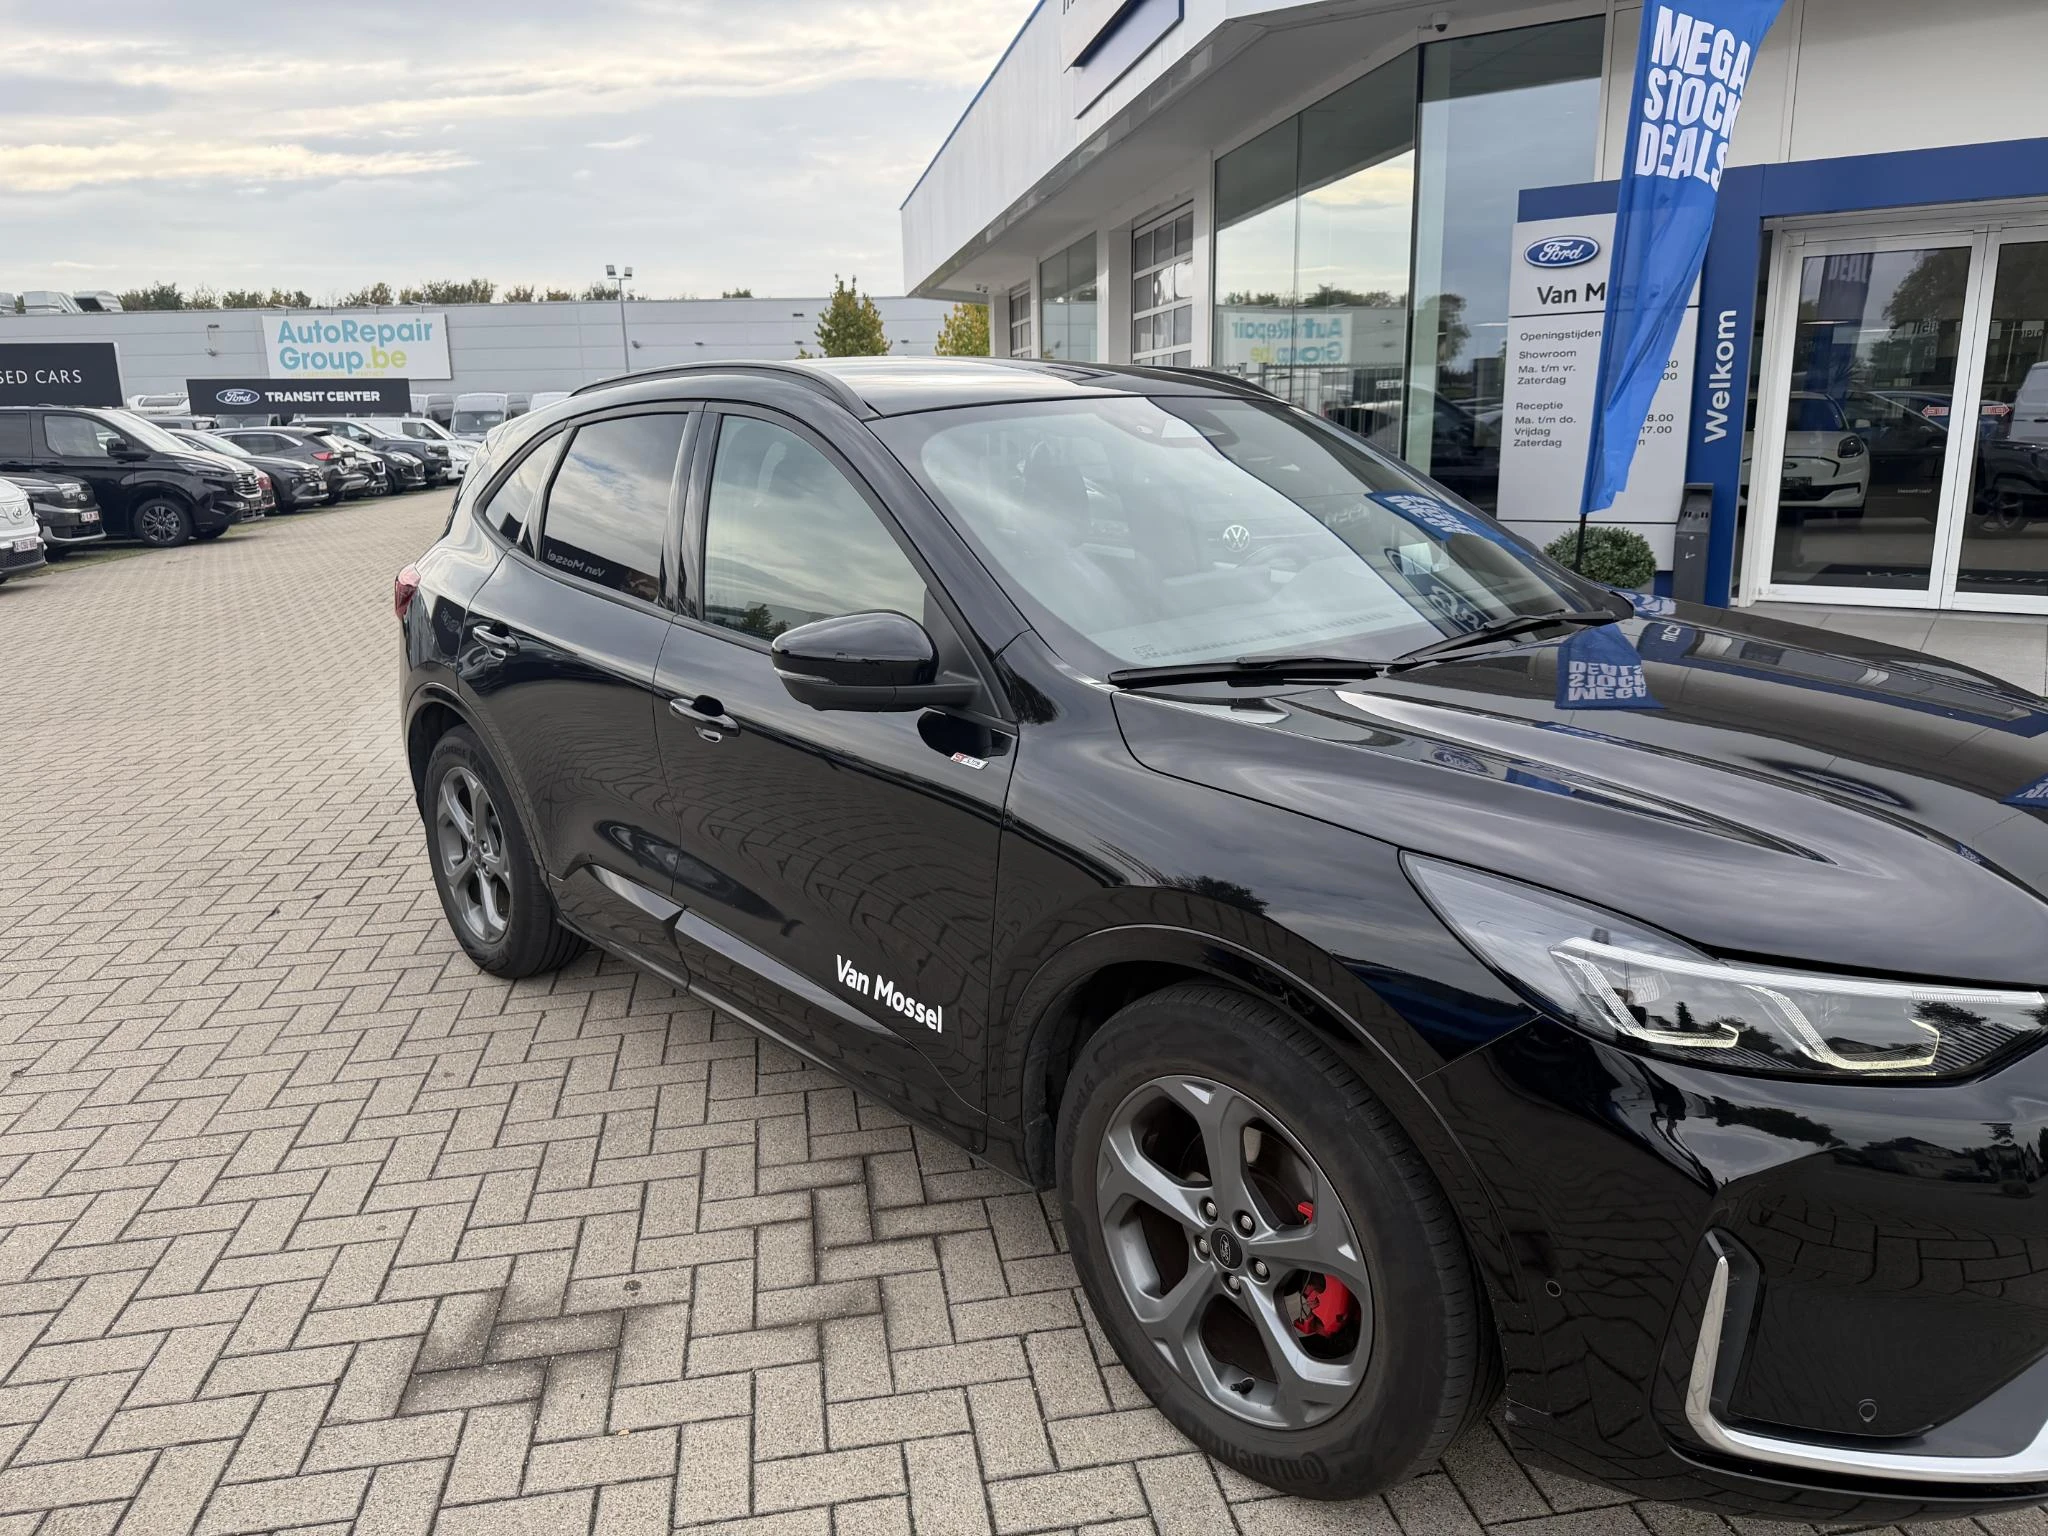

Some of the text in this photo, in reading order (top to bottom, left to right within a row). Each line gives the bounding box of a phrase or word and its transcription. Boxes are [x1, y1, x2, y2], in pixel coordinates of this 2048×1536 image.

[1651, 5, 1751, 94] MEGA
[1644, 67, 1742, 142] STOCK
[1635, 122, 1729, 192] DEALS
[1535, 239, 1588, 264] Ford
[1537, 286, 1577, 305] Van
[277, 319, 433, 347] AutoRepair
[1520, 330, 1602, 341] Openingstijden
[279, 345, 407, 374] Group.be
[1519, 350, 1577, 359] Showroom
[1518, 363, 1577, 374] Ma. t/m vr.
[35, 369, 82, 384] CARS
[1517, 376, 1567, 386] Zaterdag
[1704, 310, 1737, 443] Welkom
[222, 390, 381, 404] Ford TRANSIT CENTER
[1516, 402, 1564, 411] Receptie
[1515, 415, 1577, 424] Ma. t/m do.
[1646, 413, 1674, 422] 8.00
[1514, 427, 1551, 437] Vrijdag
[1513, 439, 1563, 449] Zaterdag
[837, 954, 943, 1034] Van Mossel
